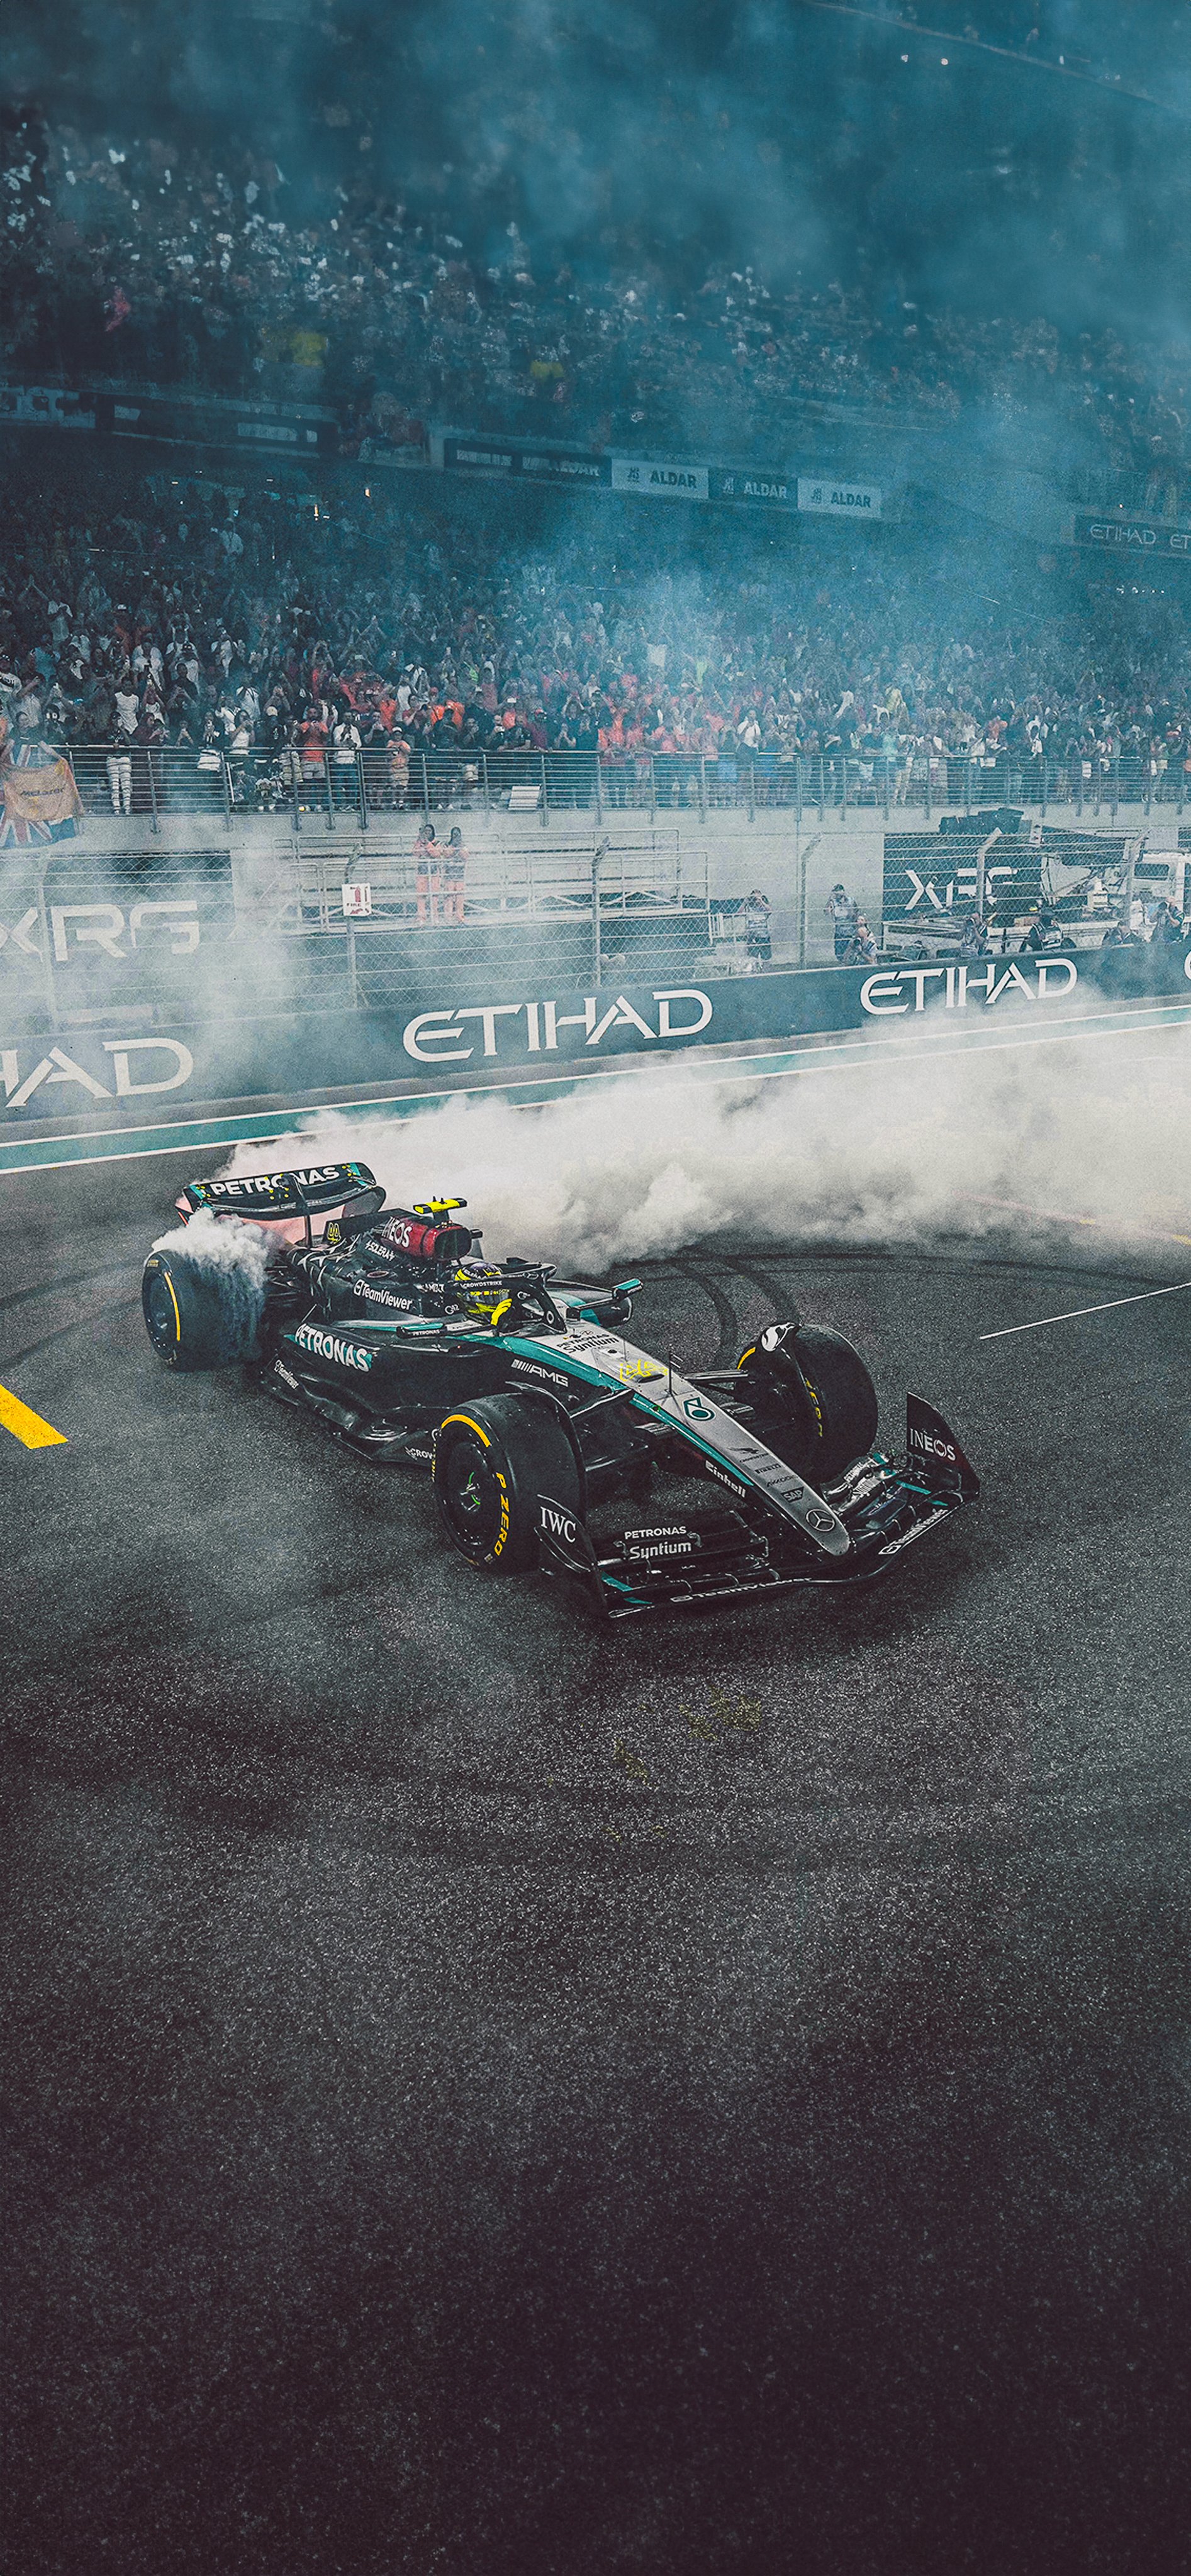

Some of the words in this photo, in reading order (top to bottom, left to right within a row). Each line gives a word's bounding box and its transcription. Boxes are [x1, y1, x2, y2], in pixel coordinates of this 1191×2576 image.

[649, 469, 697, 489] ALDAR
[744, 482, 787, 499] ALDAR
[830, 491, 871, 508] ALDAR
[1090, 524, 1156, 545] ETIHAD
[860, 958, 1077, 1015] ETIHAD
[403, 989, 713, 1063] ETIHAD
[381, 1216, 412, 1248] INEOS
[362, 1282, 413, 1310] TeamViewer
[295, 1323, 369, 1372] PETRONAS
[556, 1334, 610, 1347] PETRONAS
[563, 1337, 619, 1353] Syntium
[530, 1366, 568, 1387] AMG
[910, 1428, 956, 1461] INEOS
[496, 1472, 506, 1489] P
[705, 1460, 746, 1498] Einhell
[783, 1491, 803, 1502] SAP
[495, 1494, 510, 1556] ZERO
[540, 1506, 576, 1543] IWC
[624, 1526, 687, 1540] PETRONAS
[629, 1541, 691, 1559] Syntium
